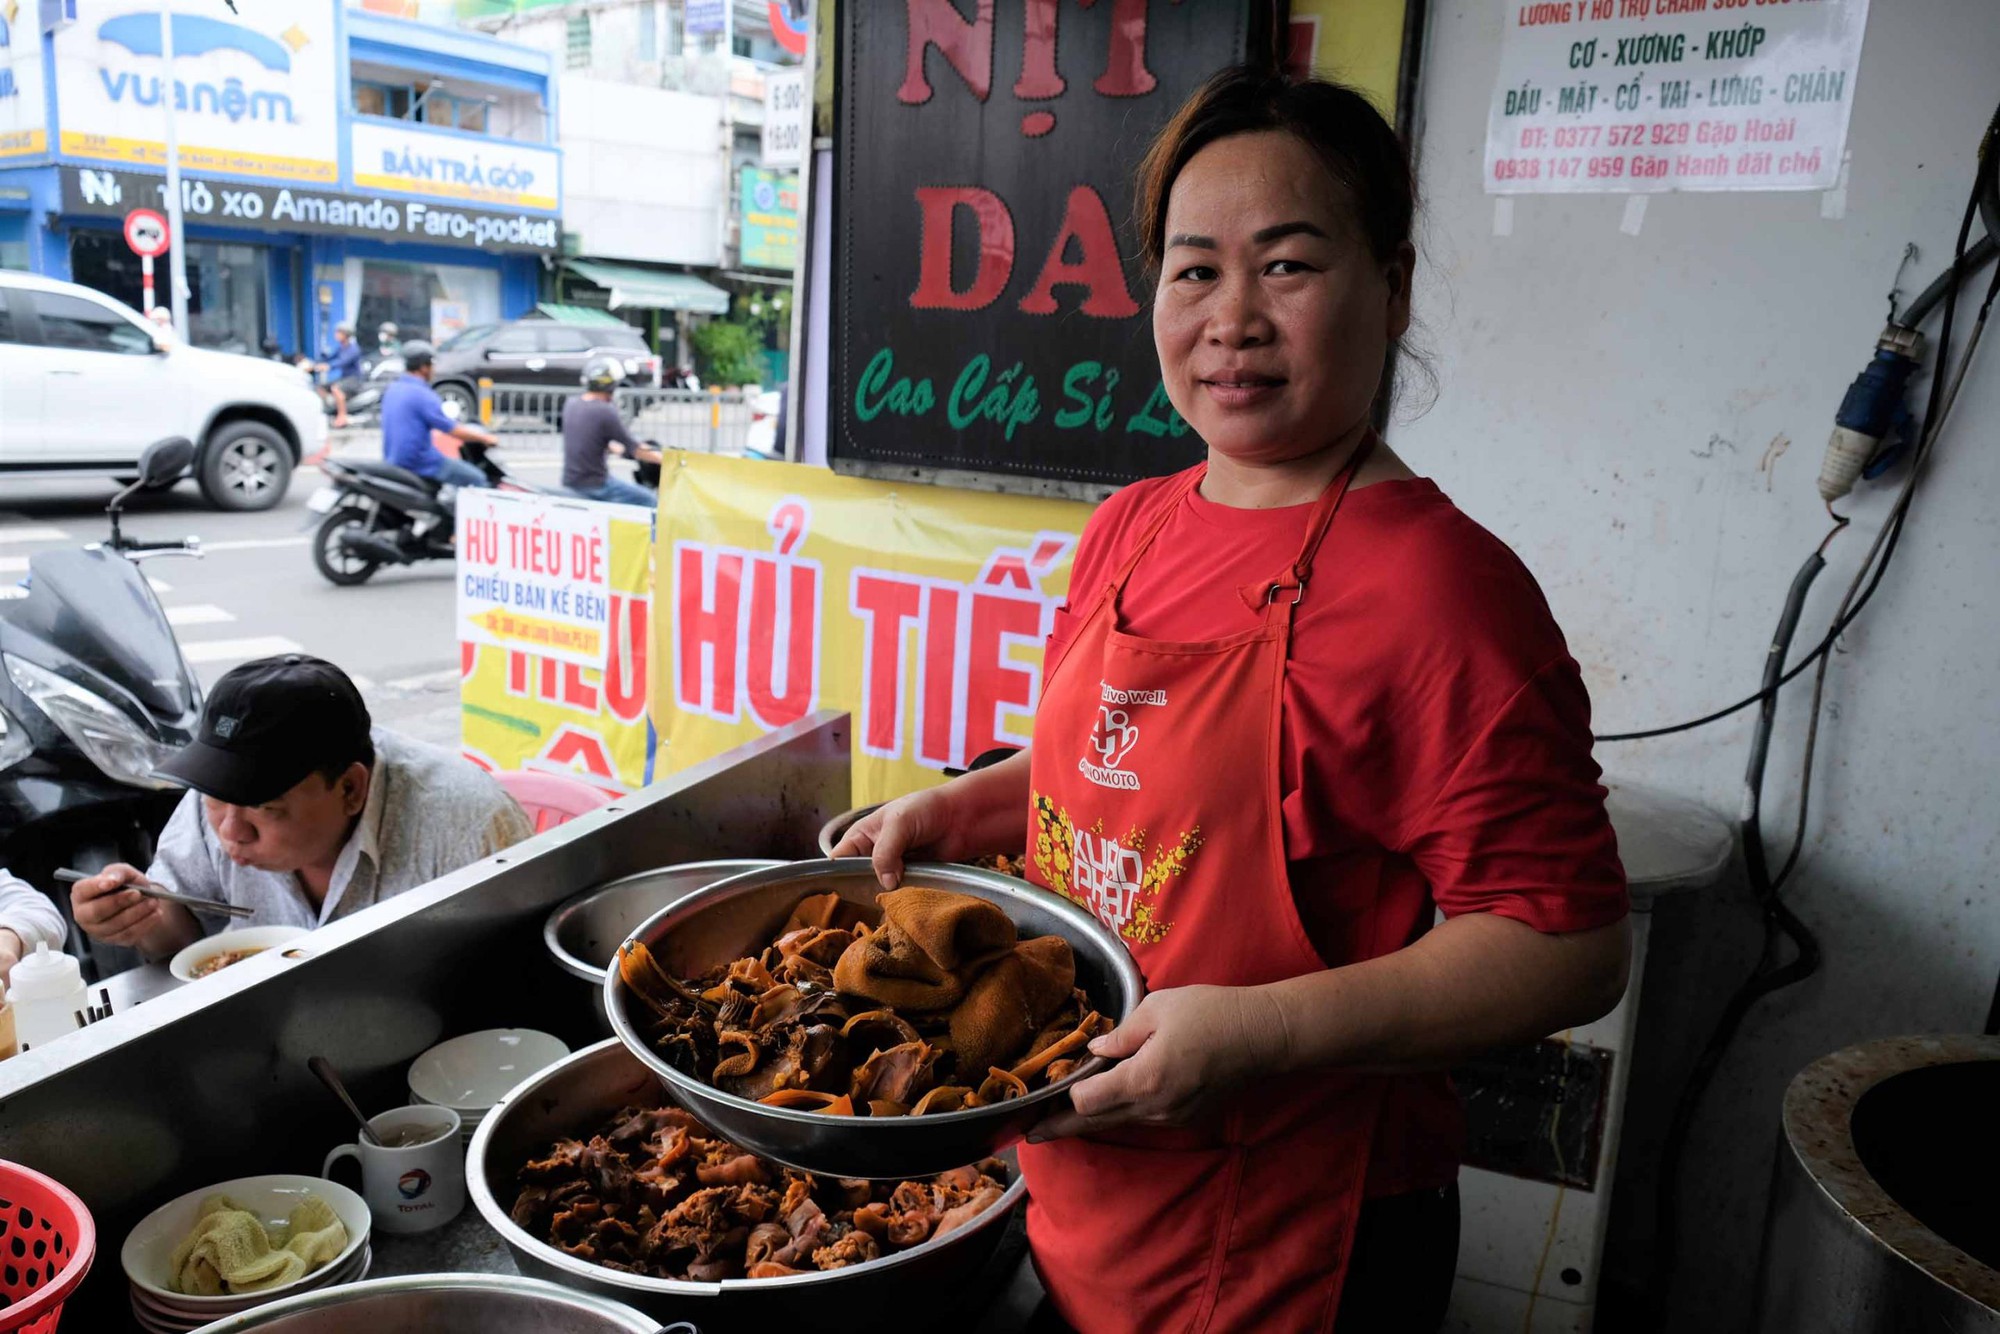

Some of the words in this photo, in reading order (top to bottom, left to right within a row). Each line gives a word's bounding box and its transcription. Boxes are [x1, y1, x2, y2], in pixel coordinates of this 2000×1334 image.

[1577, 1, 1588, 21] Y
[1569, 37, 1598, 68] CƠ
[1614, 33, 1685, 66] XƯƠNG
[1705, 21, 1766, 60] KHỚP
[897, 0, 1182, 137] NỊT
[1660, 80, 1690, 109] VAI
[1708, 74, 1764, 107] LƯNG
[1784, 66, 1846, 104] CHÂN
[1555, 125, 1603, 147] 0377
[1608, 124, 1646, 146] 572
[1651, 122, 1690, 144] 929
[438, 155, 484, 186] TRẢ
[489, 162, 534, 191] GÓP
[1548, 157, 1582, 179] 147
[1588, 156, 1625, 179] 959
[220, 189, 264, 219] xo
[272, 188, 400, 231] Amando
[406, 202, 558, 248] Faro-pocket
[910, 185, 1140, 319] DA
[855, 348, 937, 423] Cao
[947, 353, 1041, 441] Cấp
[1055, 361, 1121, 433] Sỉ
[466, 504, 498, 566] HỦ
[507, 512, 562, 577] TIẾU
[571, 525, 603, 585] DÊ
[515, 579, 546, 611] BÁN
[574, 589, 606, 623] BÊN
[678, 500, 816, 728] HỦ
[855, 540, 1062, 768] TIẾ
[397, 1201, 435, 1213] TOTAL
